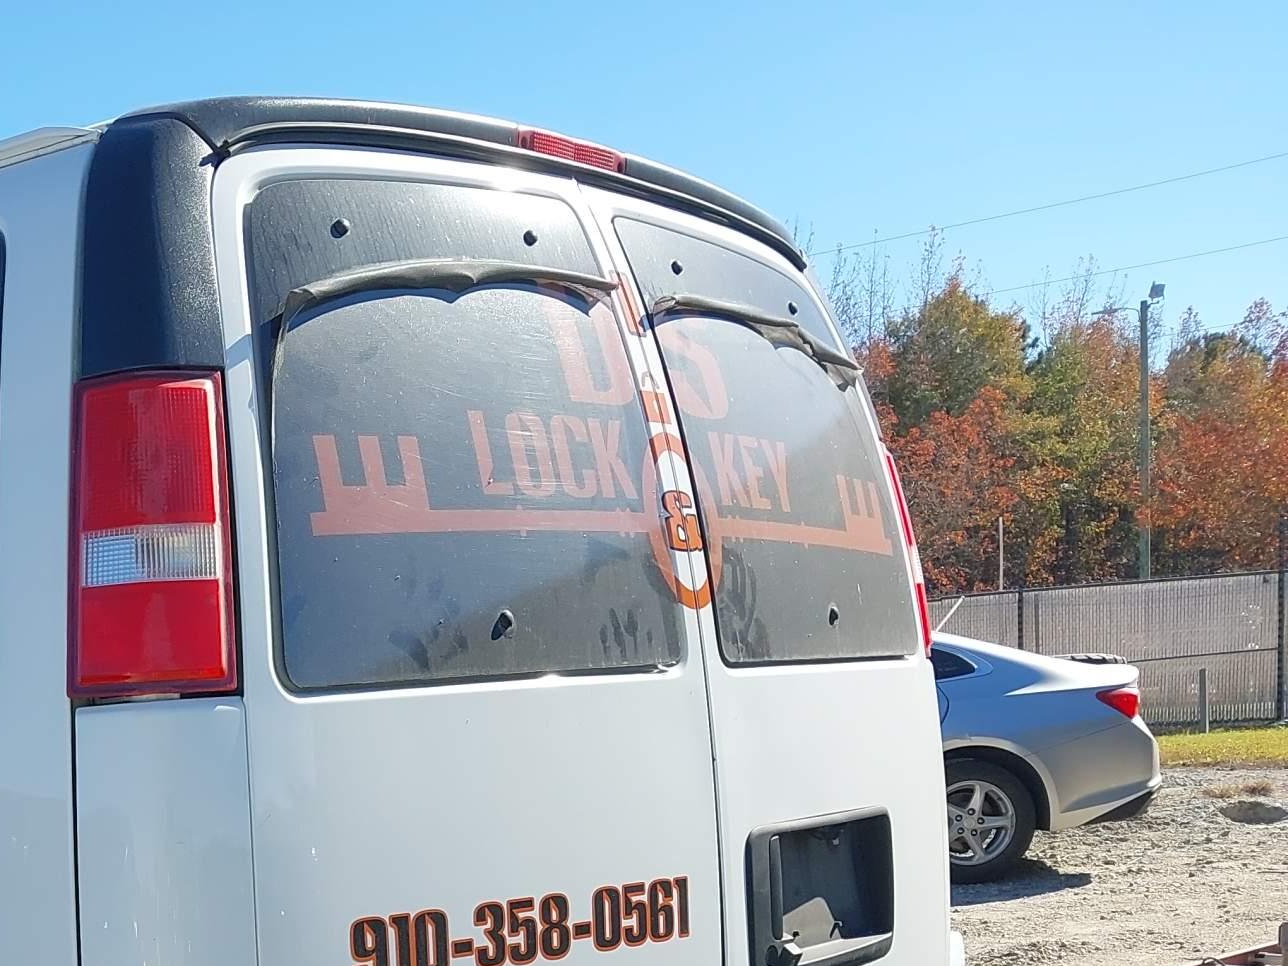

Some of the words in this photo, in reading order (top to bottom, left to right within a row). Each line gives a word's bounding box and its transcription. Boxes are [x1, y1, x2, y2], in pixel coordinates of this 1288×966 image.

[467, 409, 639, 499] LOCK
[661, 489, 703, 553] &
[707, 431, 791, 513] KEY
